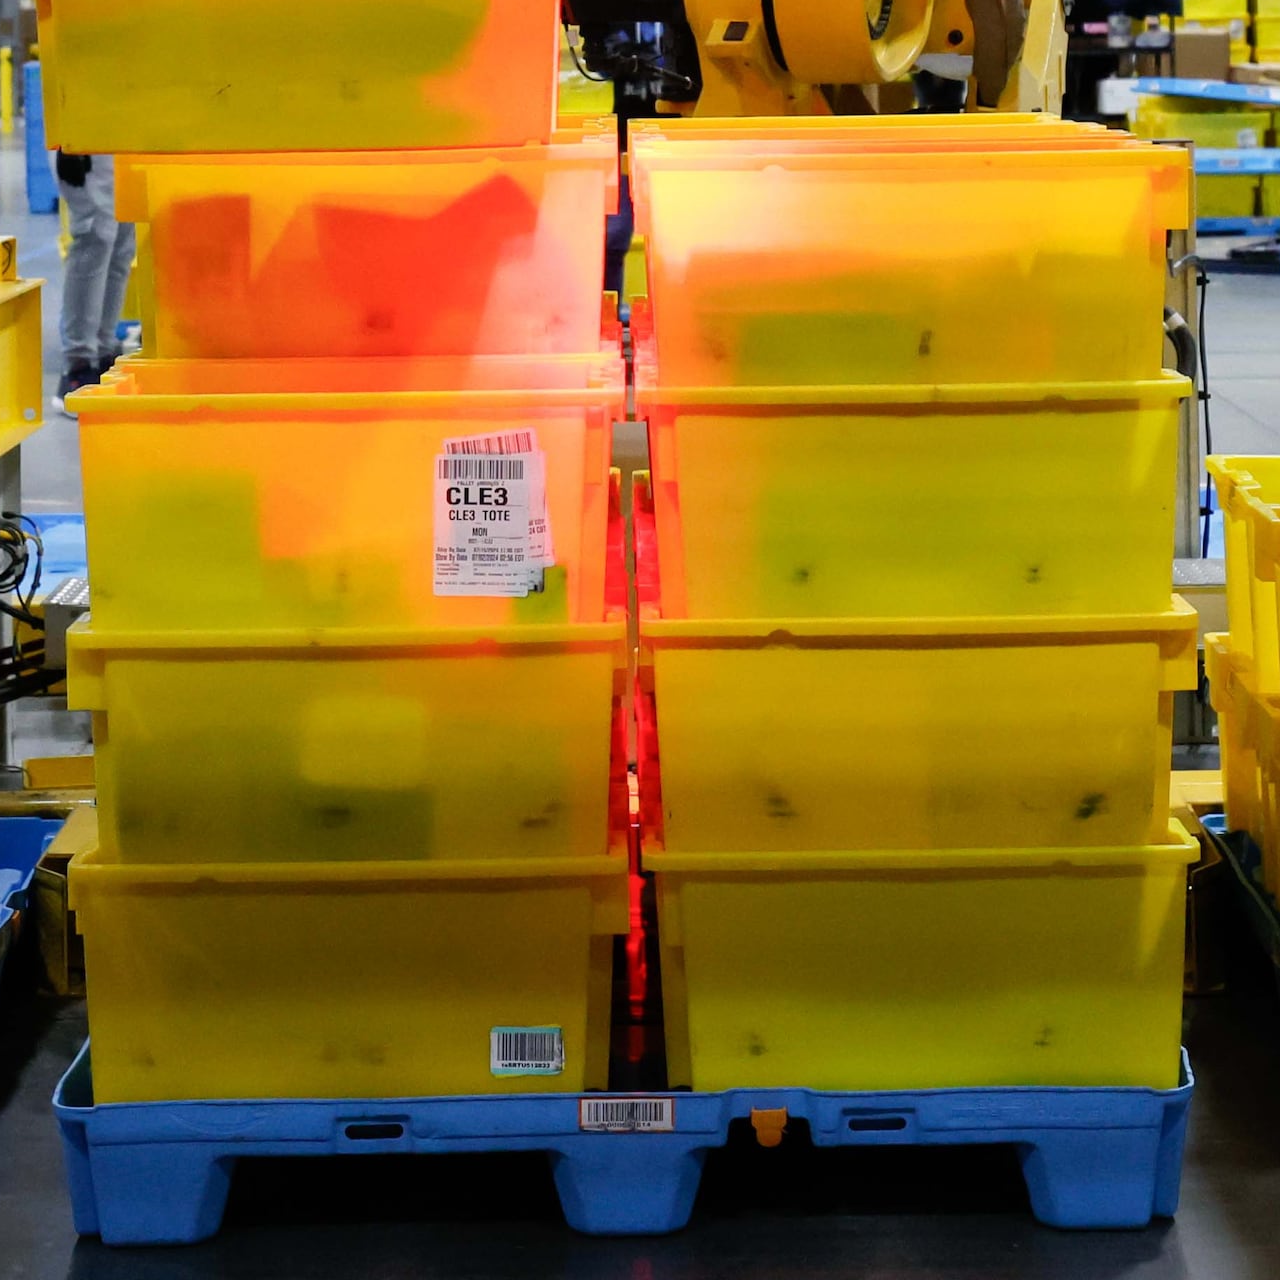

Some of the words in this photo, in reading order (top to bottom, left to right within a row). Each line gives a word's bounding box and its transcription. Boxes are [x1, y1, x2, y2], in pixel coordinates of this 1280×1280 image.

[446, 487, 509, 506] CLE3
[449, 510, 476, 521] CLE3
[483, 510, 510, 521] TOTE
[472, 528, 488, 536] MON
